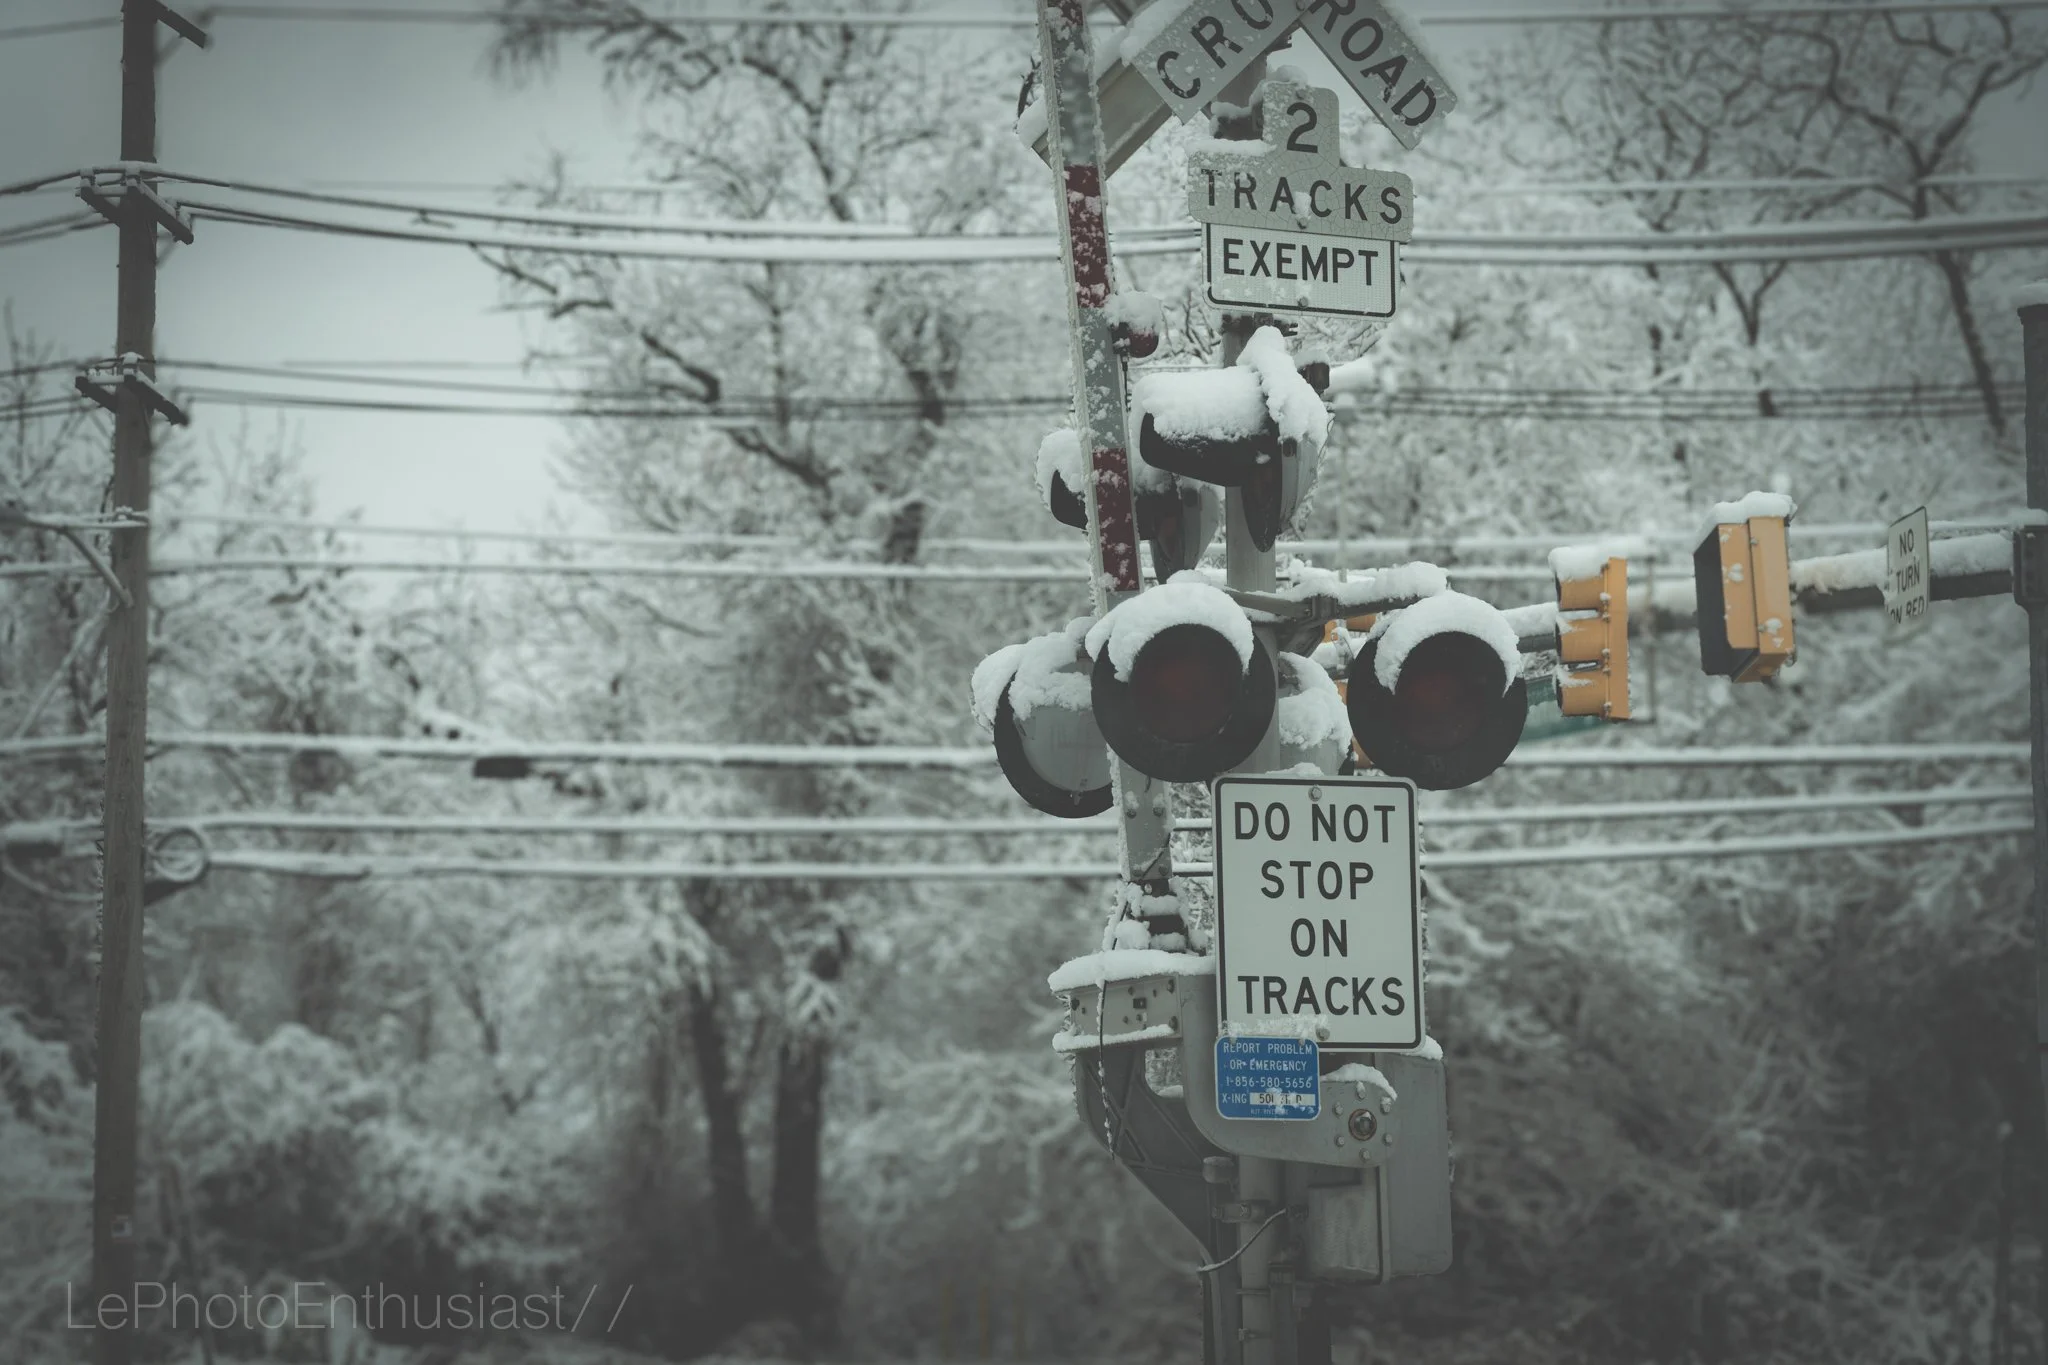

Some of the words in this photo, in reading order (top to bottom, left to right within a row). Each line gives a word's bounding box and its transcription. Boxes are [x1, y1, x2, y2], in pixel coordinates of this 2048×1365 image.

[1286, 101, 1319, 154] 2
[1200, 167, 1402, 225] TRACKS
[1222, 238, 1379, 286] EXEMPT
[1899, 528, 1915, 557] NO
[1896, 559, 1920, 594] TURN
[1906, 595, 1925, 617] RED
[1234, 801, 1290, 841] DO
[1311, 803, 1396, 843] NOT
[1260, 859, 1374, 900] STOP
[1290, 918, 1348, 958] ON
[1237, 975, 1405, 1016] TRACKS
[1223, 1042, 1260, 1053] REPORT
[1267, 1043, 1312, 1055] PROBLEM
[1249, 1059, 1307, 1071] EMERGENCY
[1222, 1093, 1247, 1104] X-ING
[1226, 1076, 1312, 1088] 1-856-580-5656
